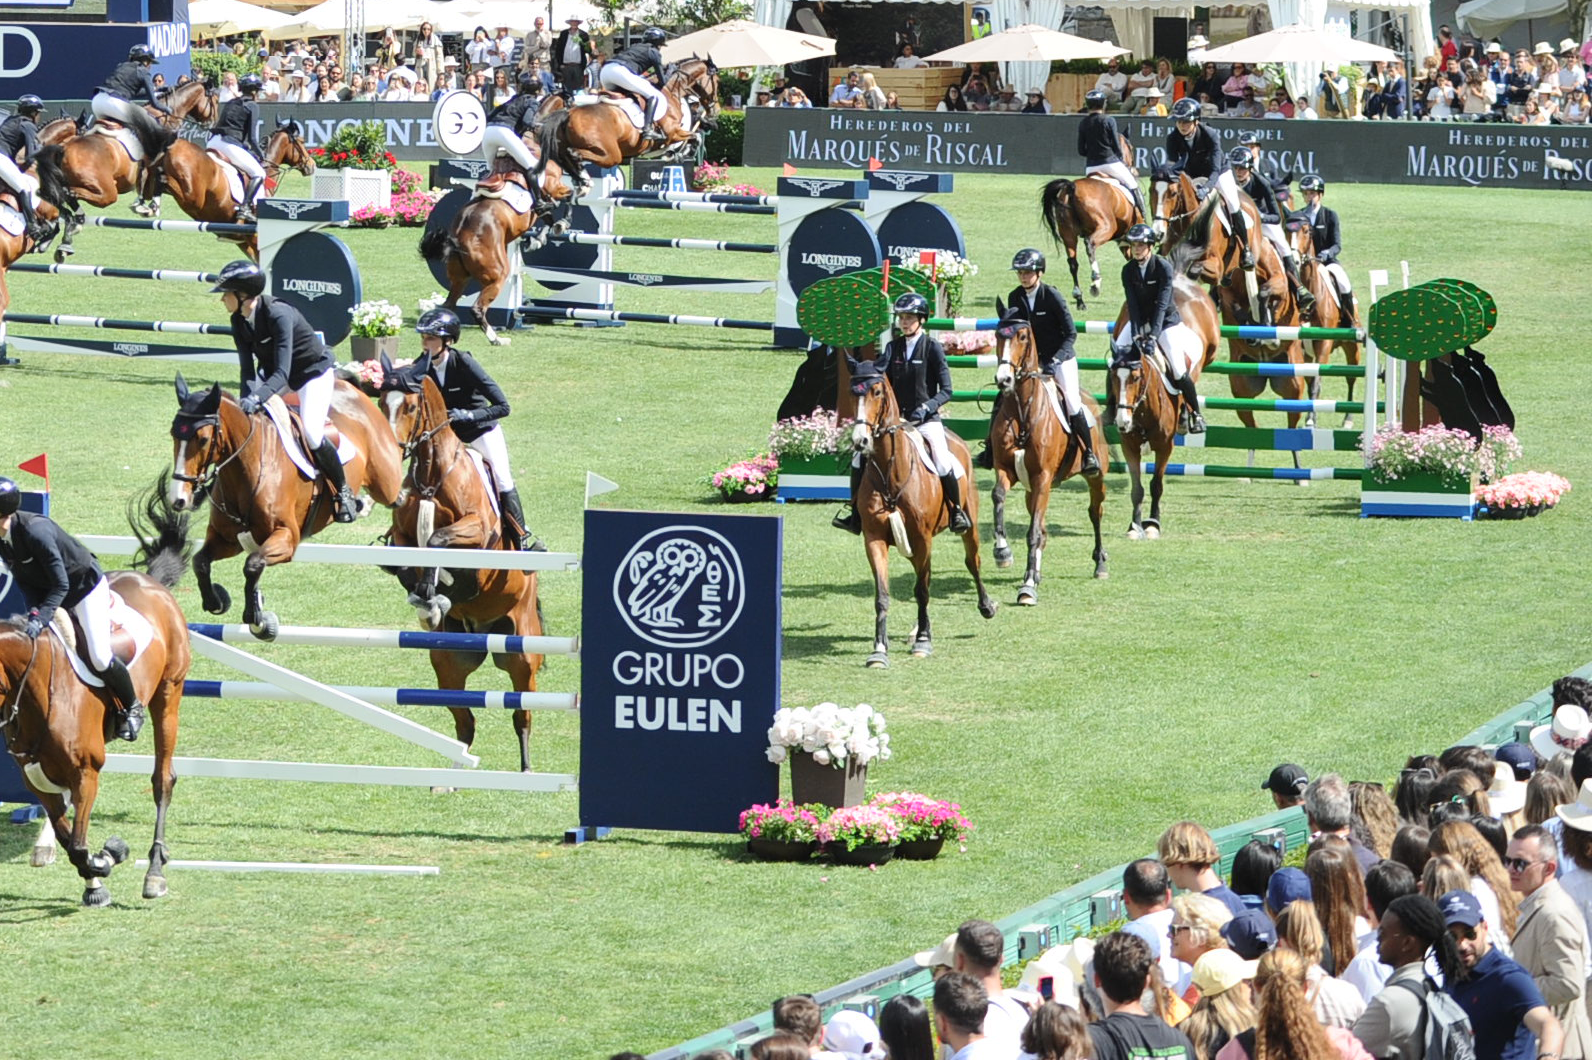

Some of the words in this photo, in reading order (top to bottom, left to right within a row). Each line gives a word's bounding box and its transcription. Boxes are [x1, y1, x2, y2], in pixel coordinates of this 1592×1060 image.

[149, 22, 188, 58] MADRID
[801, 252, 862, 268] LONGINES
[283, 278, 343, 296] LONGINES
[612, 650, 745, 689] GRUPO
[614, 695, 743, 734] EULEN
